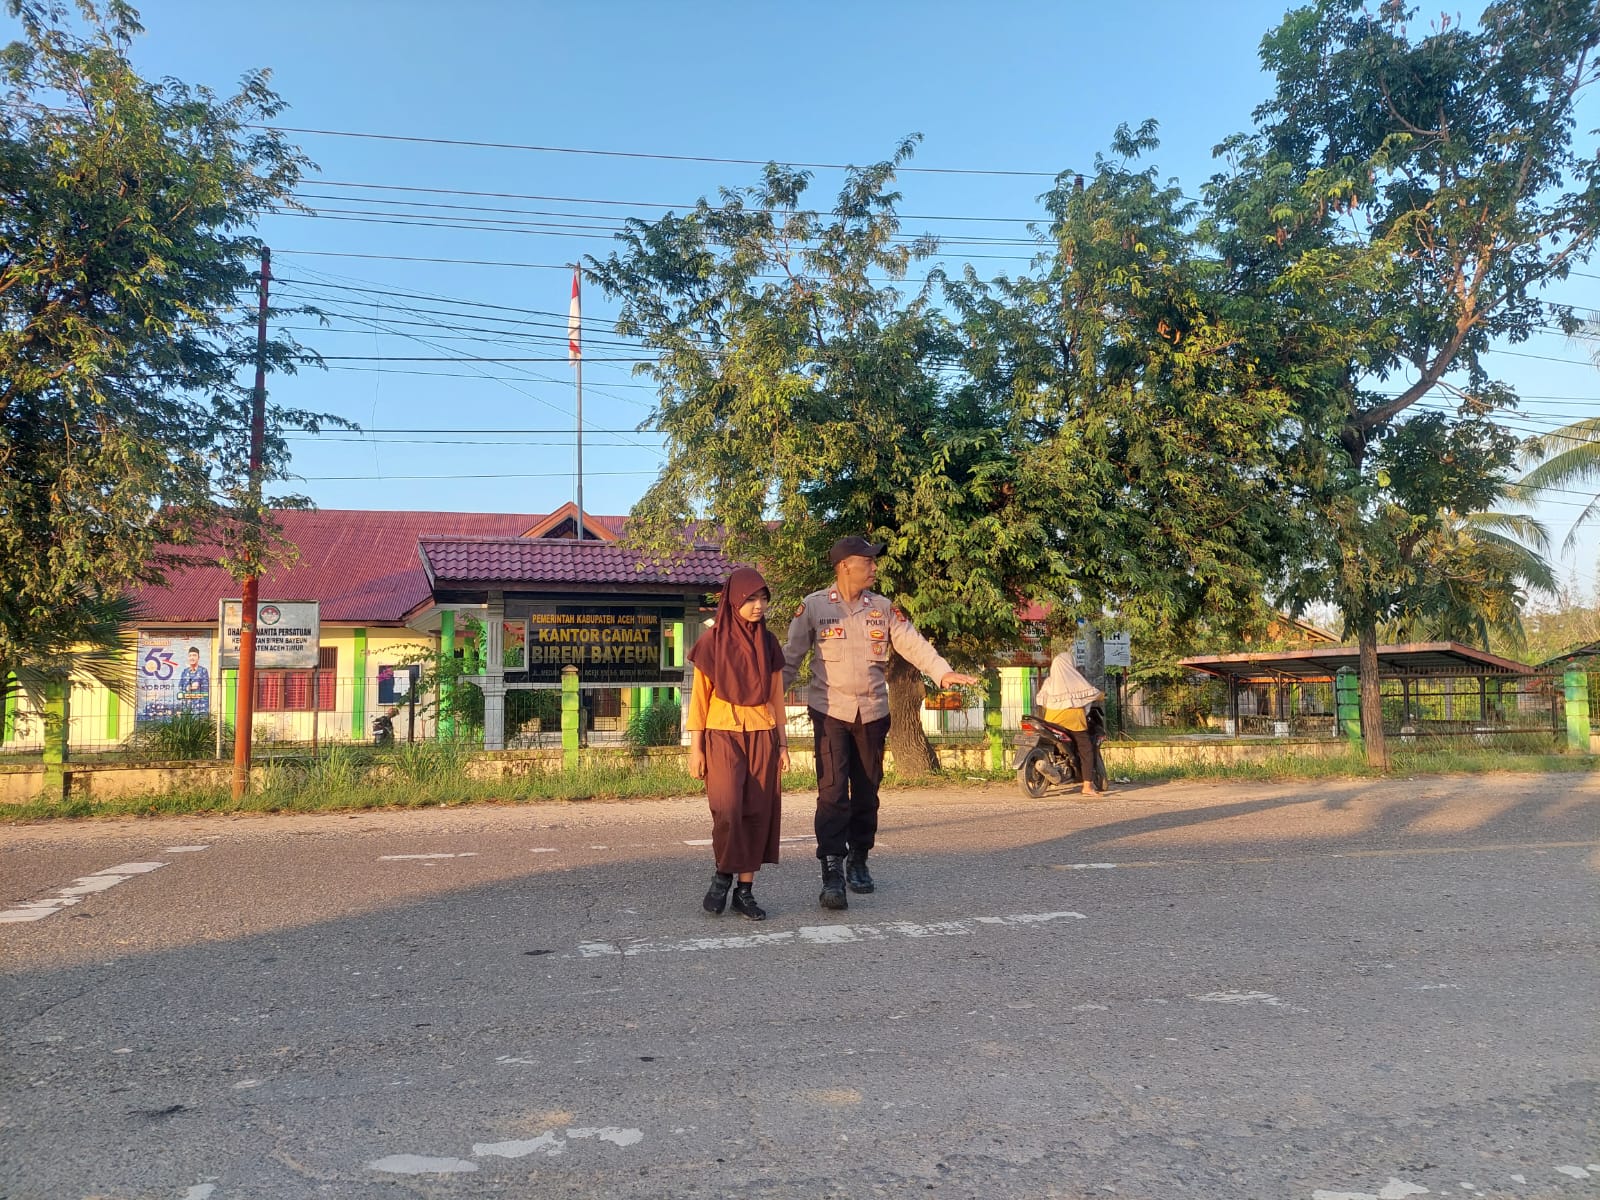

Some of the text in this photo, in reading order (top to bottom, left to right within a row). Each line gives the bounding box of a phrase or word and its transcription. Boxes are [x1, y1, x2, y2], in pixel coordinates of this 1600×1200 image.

[532, 614, 658, 625] PEMERINTAH KABUPATEN ACEH TIMUR
[278, 628, 311, 636] PERSATUAN
[538, 628, 651, 643] KANTOR CAMAT
[531, 645, 660, 664] BIREM BAYEUN
[142, 648, 174, 680] 53
